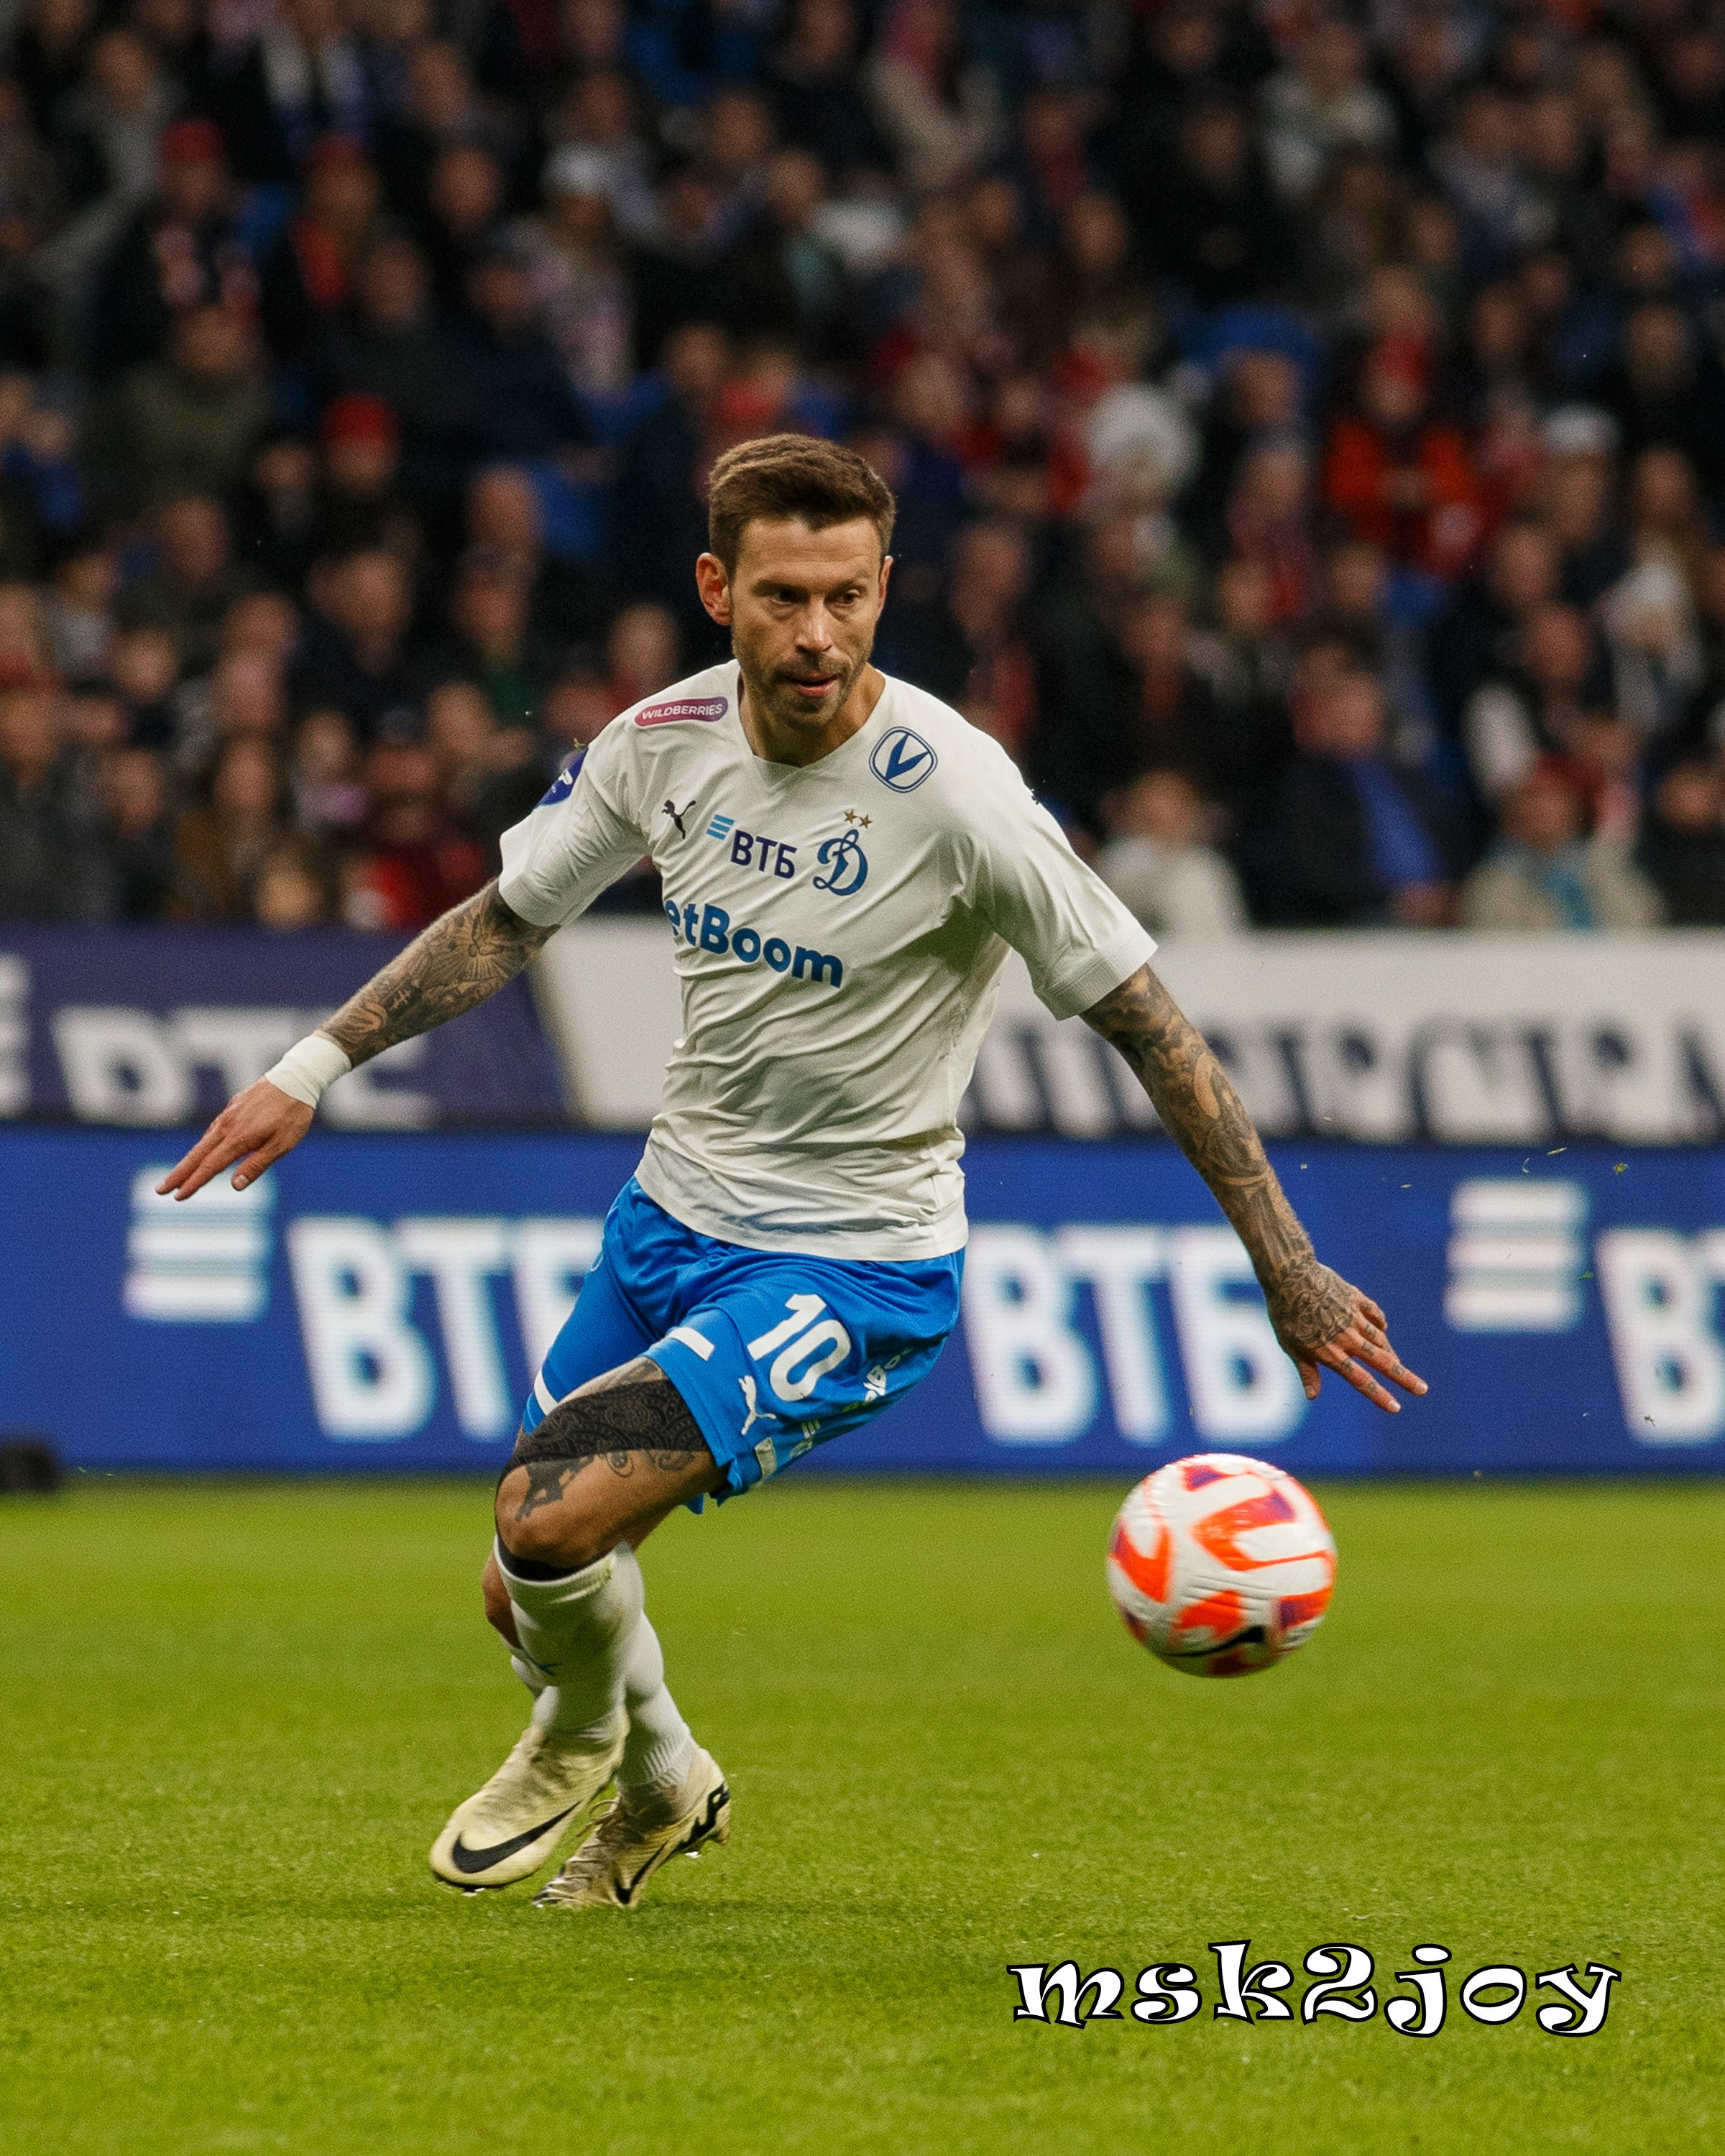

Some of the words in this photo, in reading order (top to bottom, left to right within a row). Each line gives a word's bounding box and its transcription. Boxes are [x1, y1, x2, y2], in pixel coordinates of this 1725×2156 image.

[642, 704, 723, 719] WILDBERRIES
[730, 829, 798, 880] ВТБ
[747, 1293, 851, 1402] 10
[962, 1222, 1311, 1447] ВТБ
